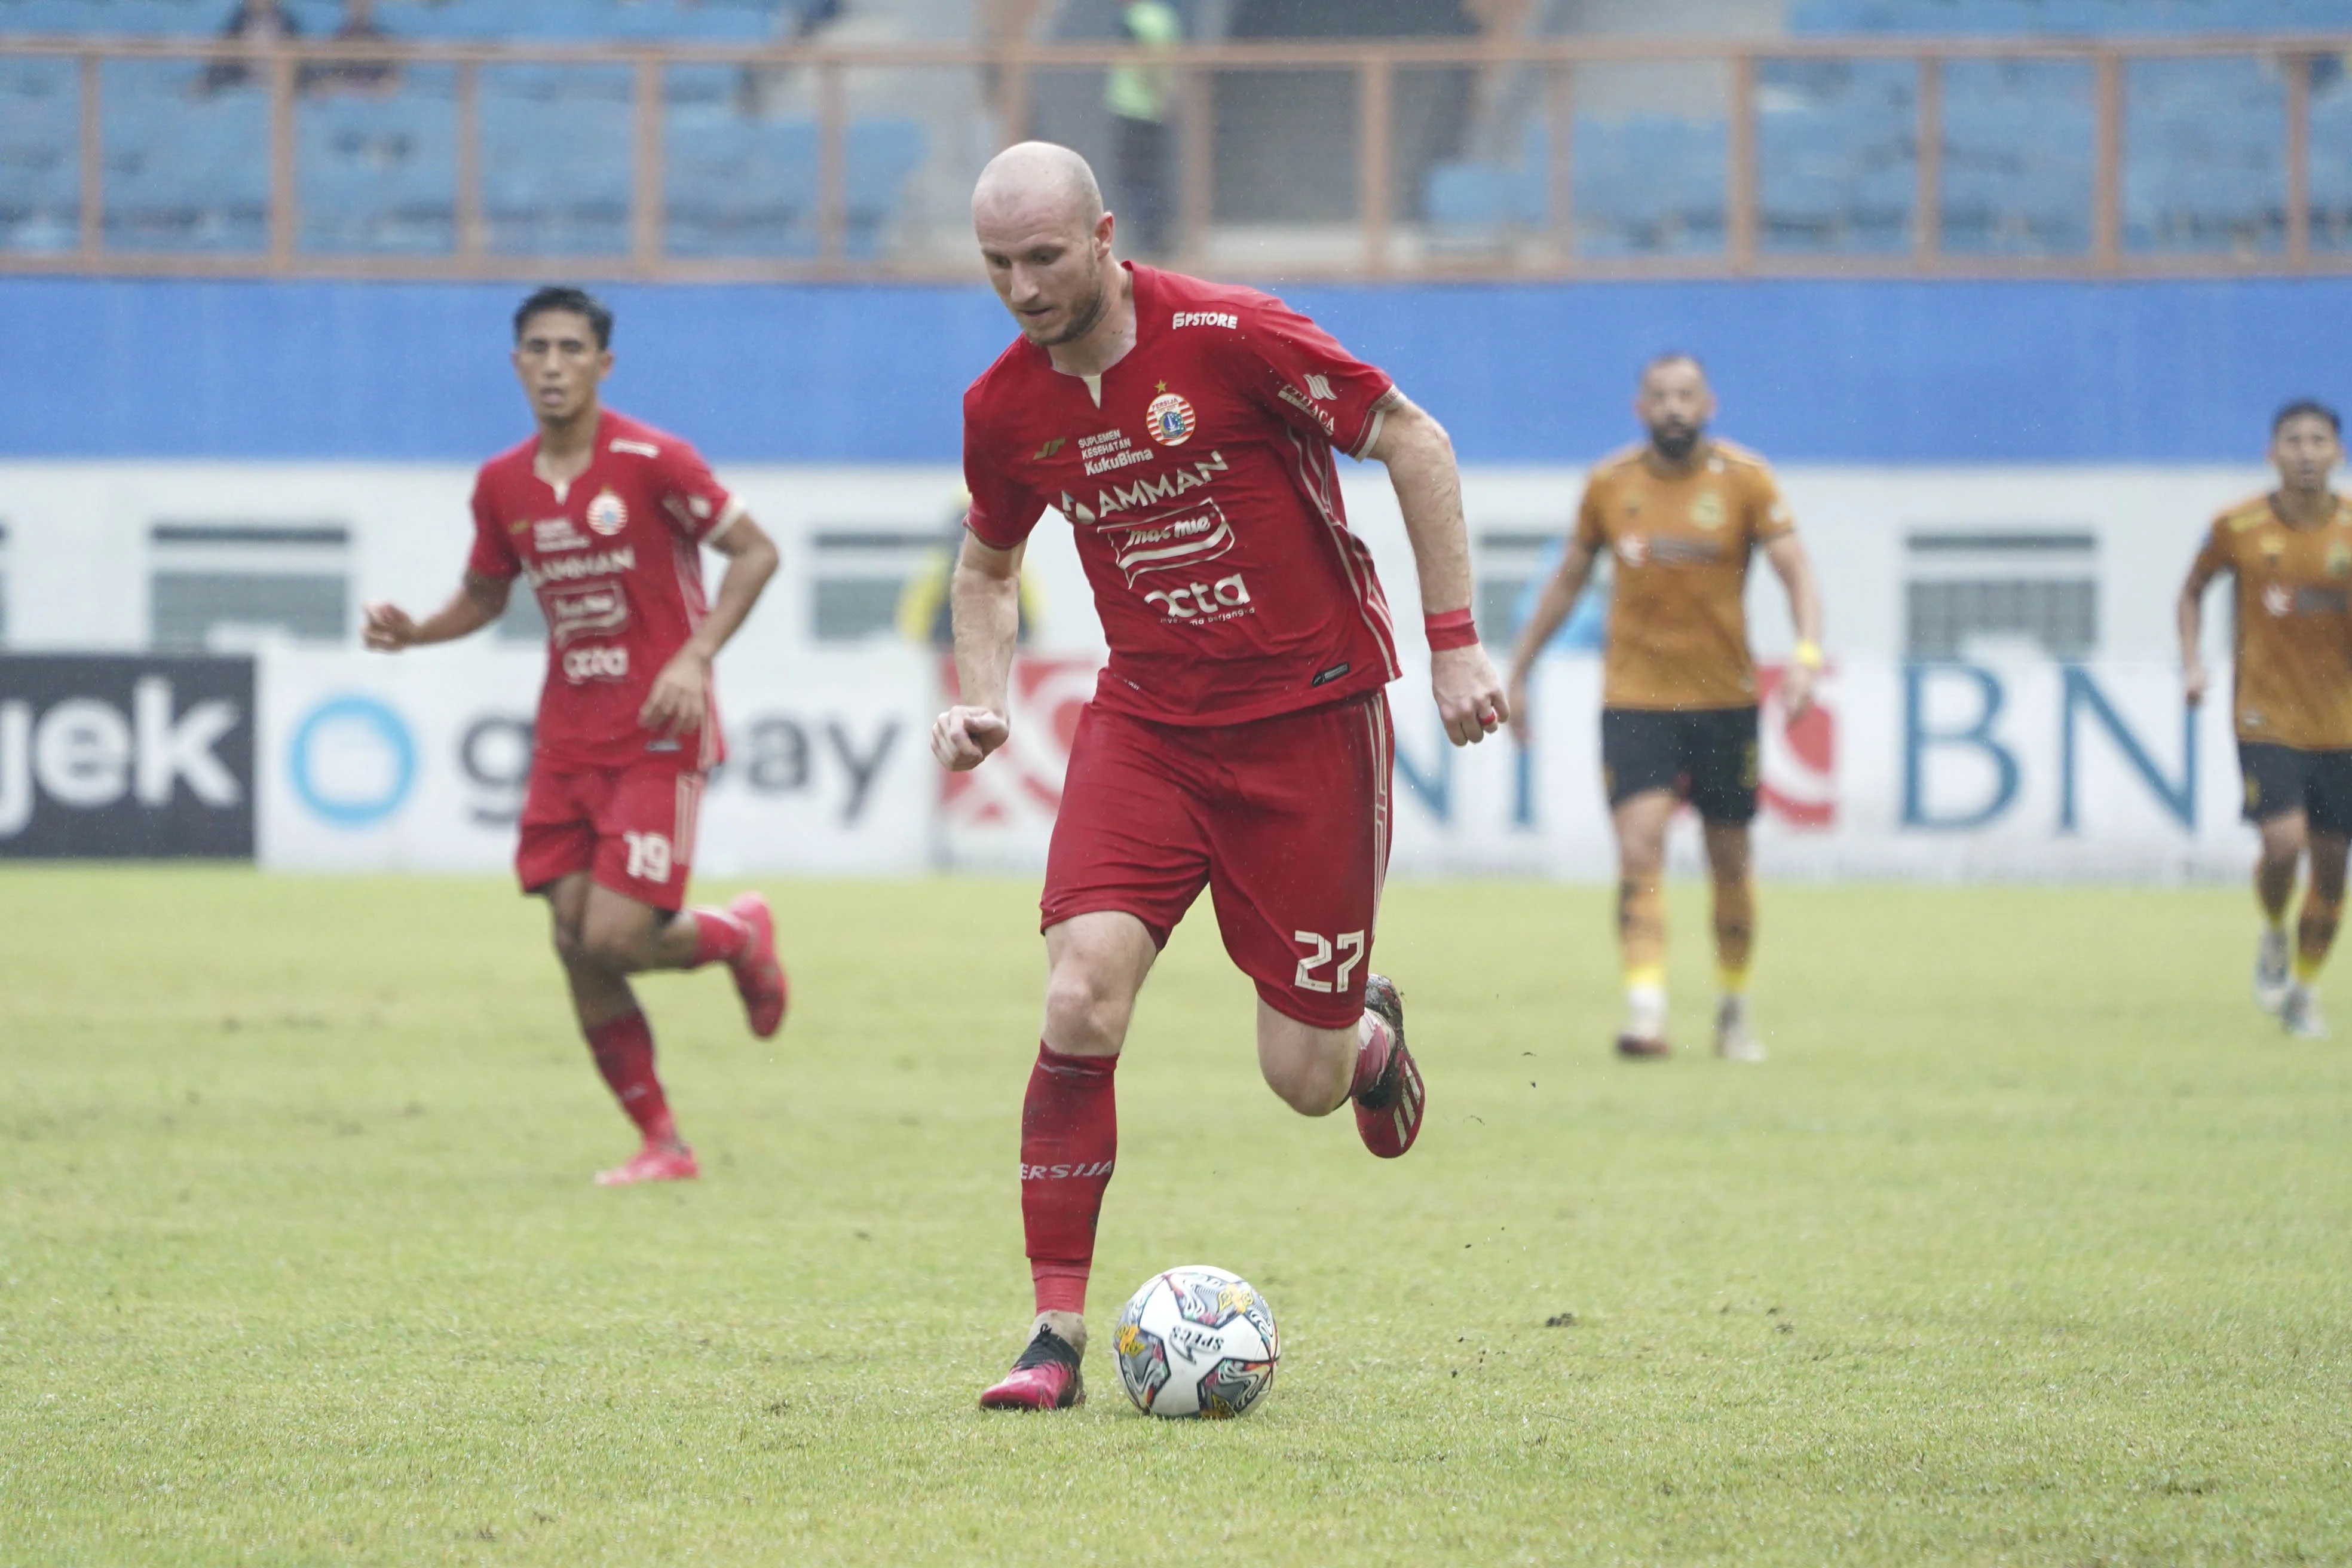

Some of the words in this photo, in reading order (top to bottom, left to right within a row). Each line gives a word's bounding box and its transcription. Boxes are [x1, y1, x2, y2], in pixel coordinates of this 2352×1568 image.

[1078, 429, 1122, 448] SUPLEMEN
[1081, 438, 1132, 460] KESEHATAN
[1083, 448, 1154, 476] KukuBima
[1099, 450, 1229, 518] AMMAN
[1173, 515, 1211, 538] mie
[1898, 660, 2202, 837] BN
[623, 830, 672, 884] 19
[1294, 929, 1365, 993] 27
